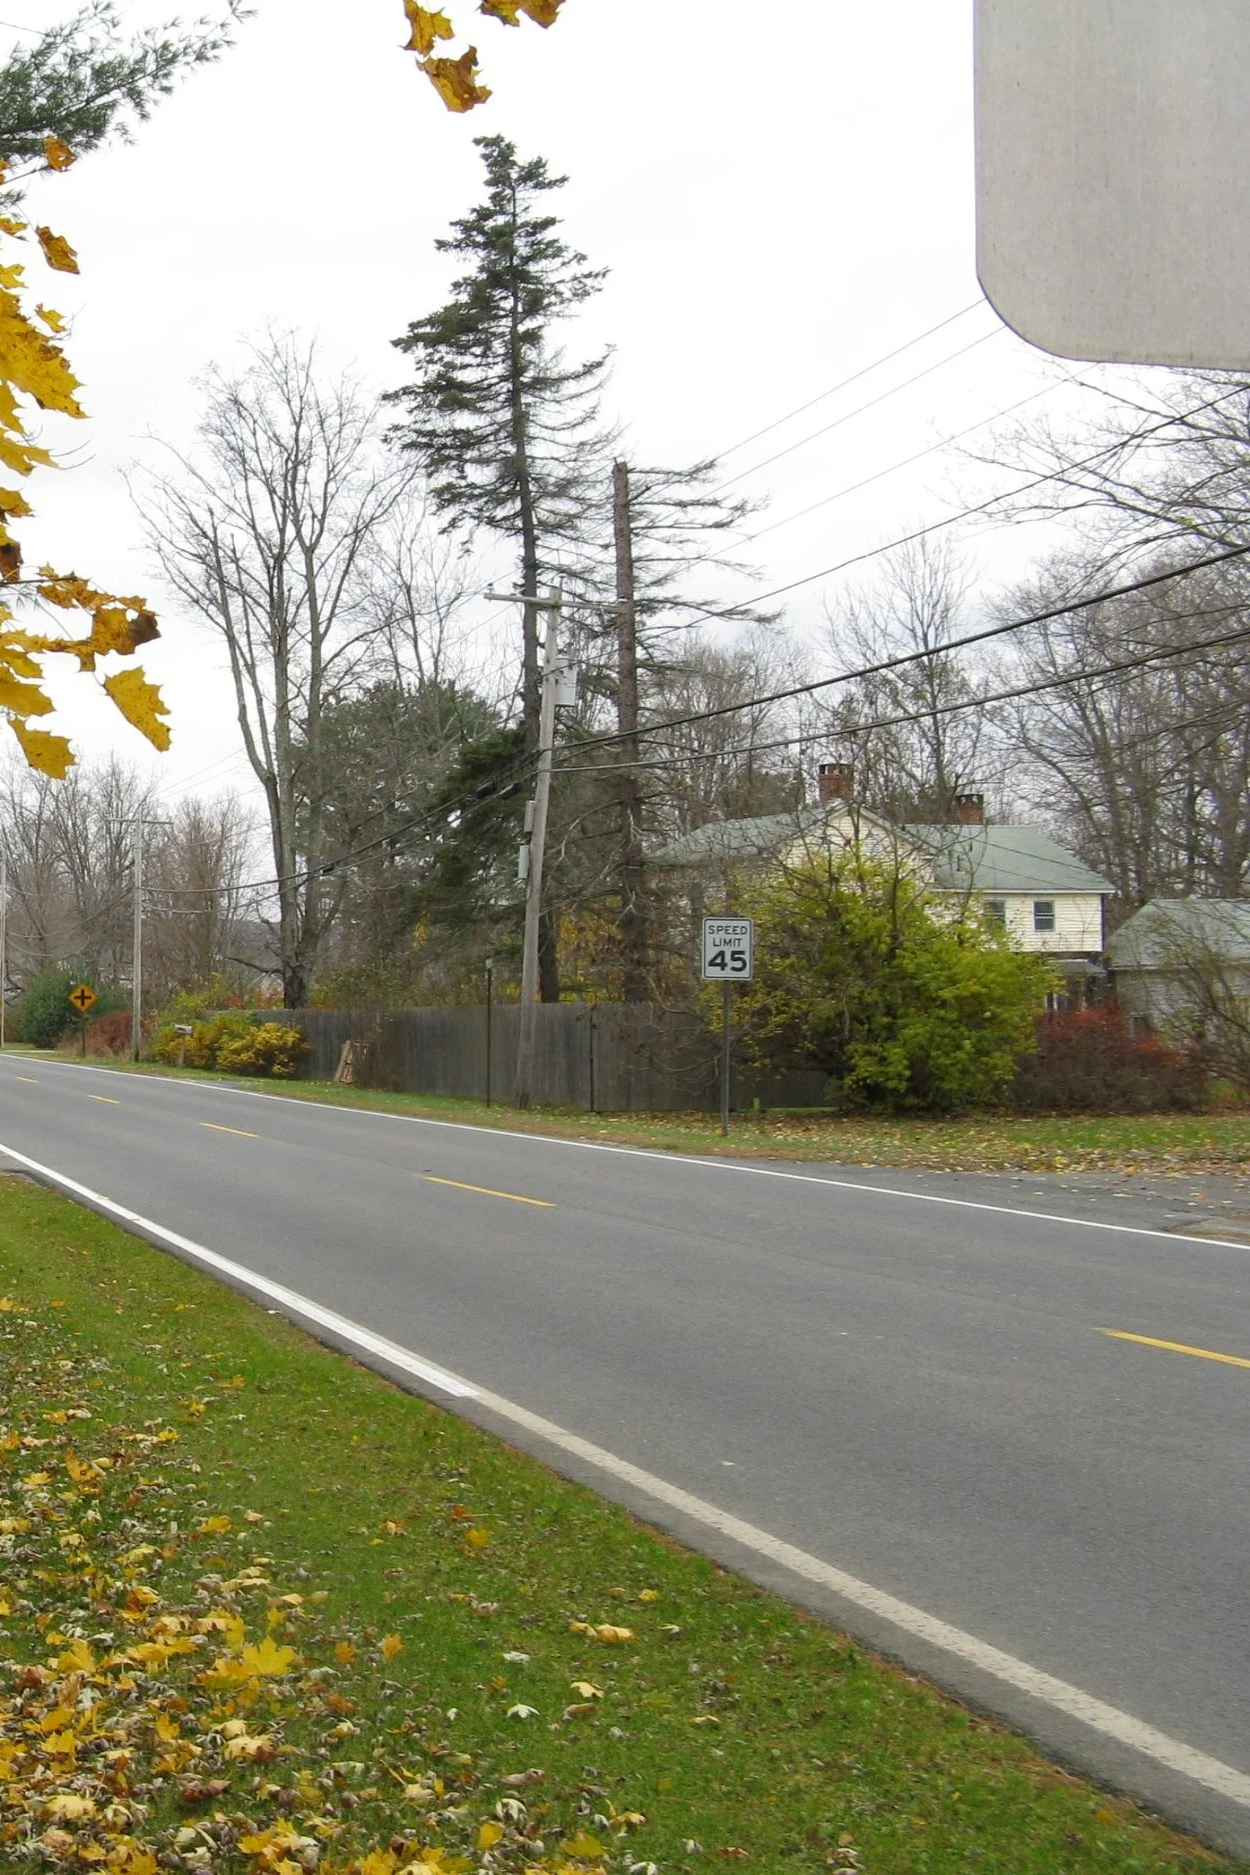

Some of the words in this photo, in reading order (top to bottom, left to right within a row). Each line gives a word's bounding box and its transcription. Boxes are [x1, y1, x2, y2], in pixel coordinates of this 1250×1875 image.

[707, 925, 748, 935] SPEED
[712, 937, 742, 947] LIMIT
[707, 950, 748, 972] 45
